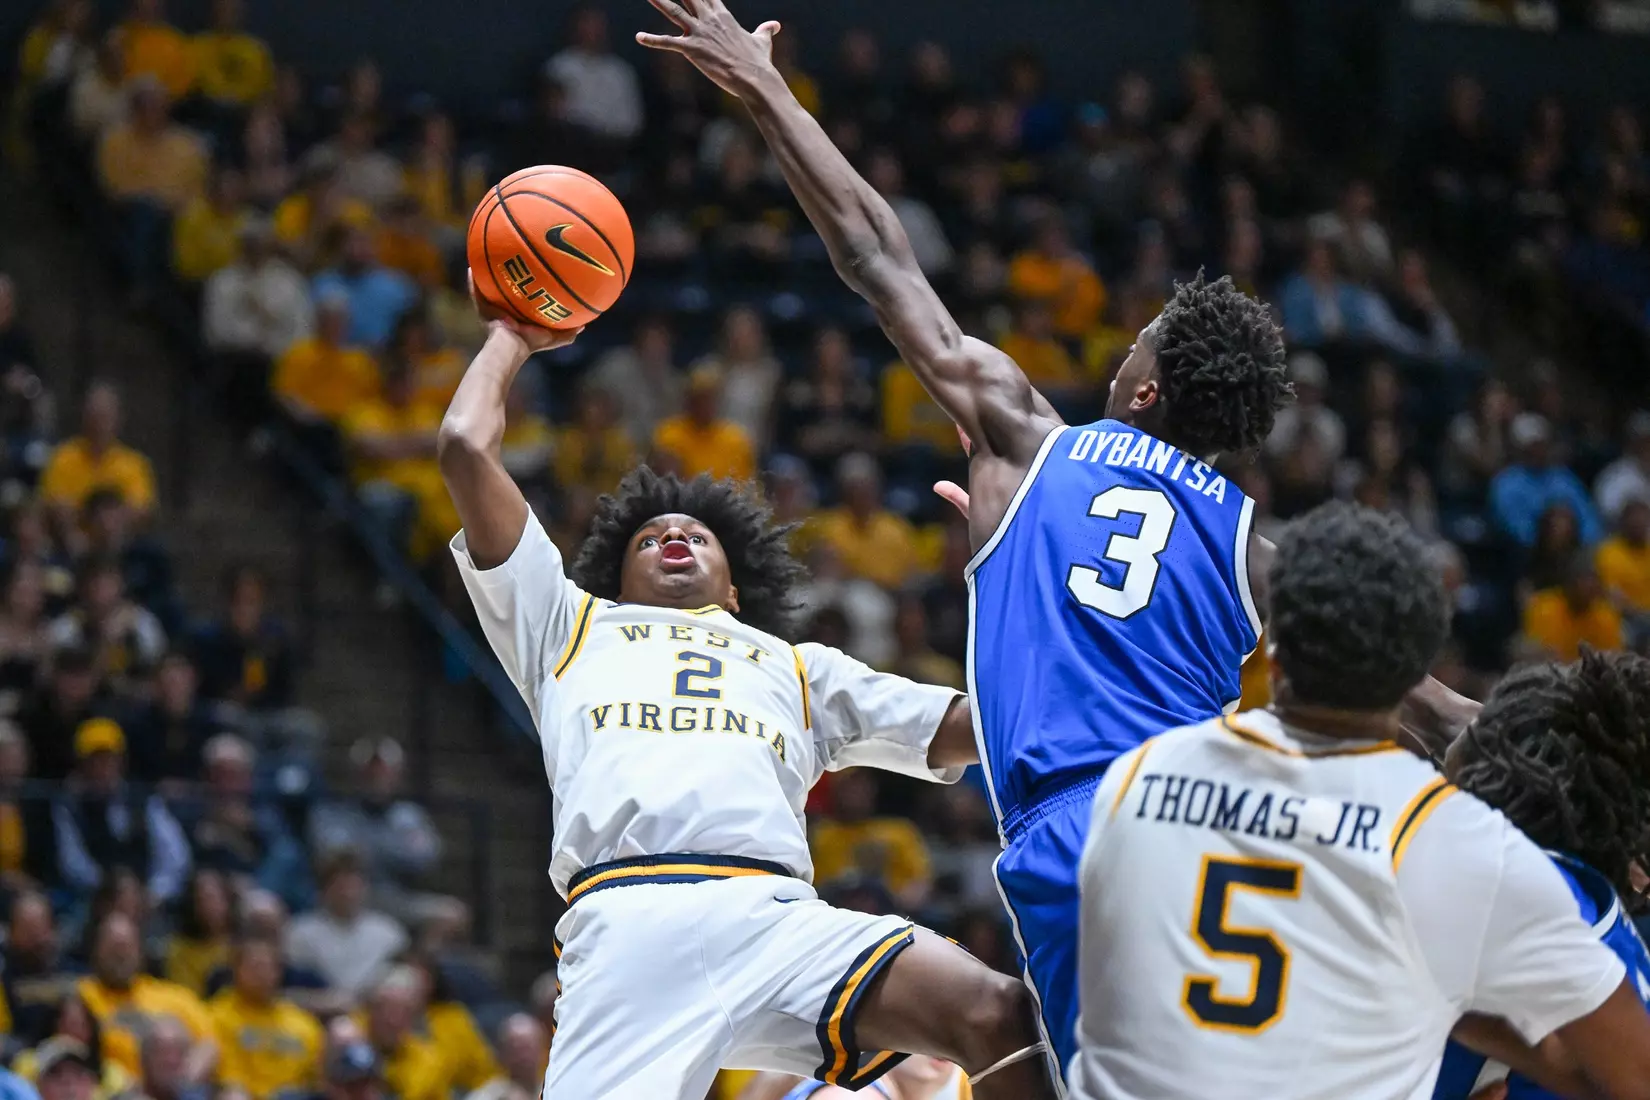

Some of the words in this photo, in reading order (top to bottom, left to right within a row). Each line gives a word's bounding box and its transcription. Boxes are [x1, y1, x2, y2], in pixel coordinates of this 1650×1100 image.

[503, 254, 574, 322] ELITE
[1068, 430, 1227, 504] DYBANTSA
[1065, 484, 1179, 621] 3
[617, 624, 771, 664] WEST
[672, 650, 725, 701] 2
[590, 701, 787, 765] VIRGINIA
[1135, 773, 1306, 842] THOMAS
[1316, 801, 1382, 853] JR.
[1180, 852, 1304, 1036] 5
